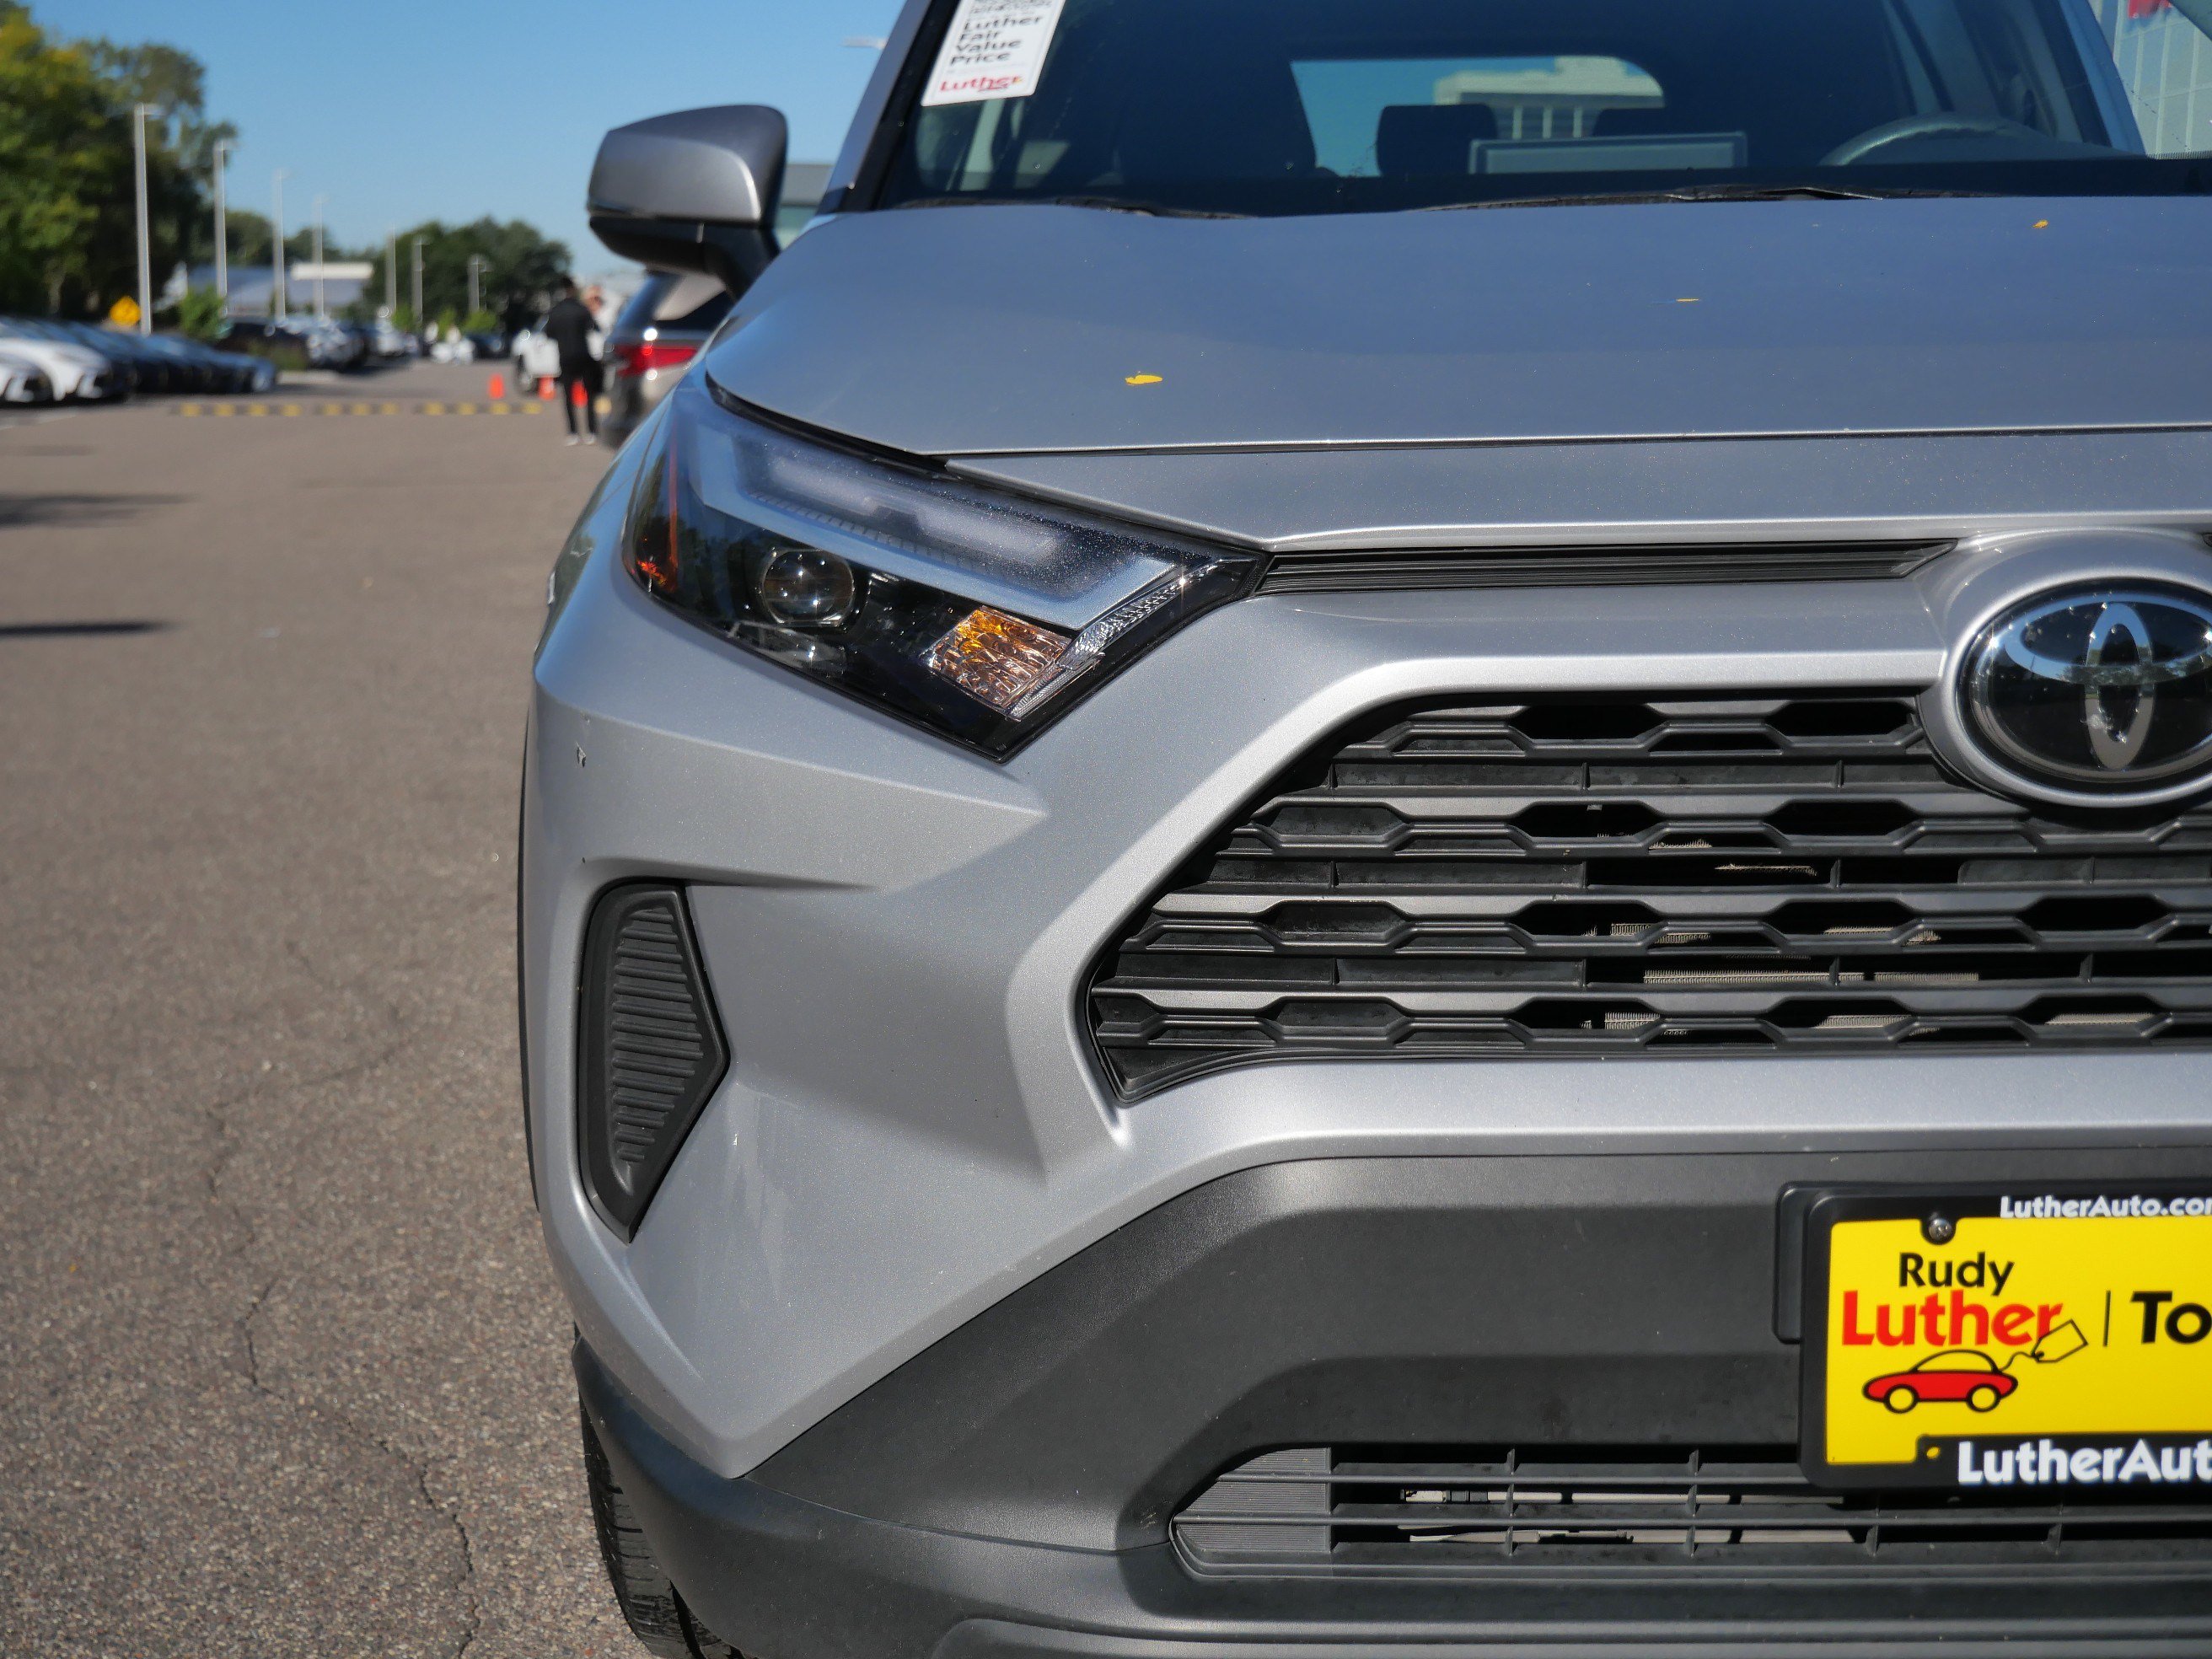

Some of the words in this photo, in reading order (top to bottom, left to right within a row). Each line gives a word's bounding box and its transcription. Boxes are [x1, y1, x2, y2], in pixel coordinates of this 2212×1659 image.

[964, 16, 1041, 30] Luther
[959, 31, 1001, 41] Fair
[956, 40, 1022, 52] Value
[950, 52, 1011, 66] Price
[940, 76, 1023, 92] Luther
[1898, 1252, 2015, 1297] Rudy
[1842, 1289, 2064, 1346] Luther
[2130, 1291, 2212, 1345] To
[1957, 1438, 2212, 1485] LutherAut
